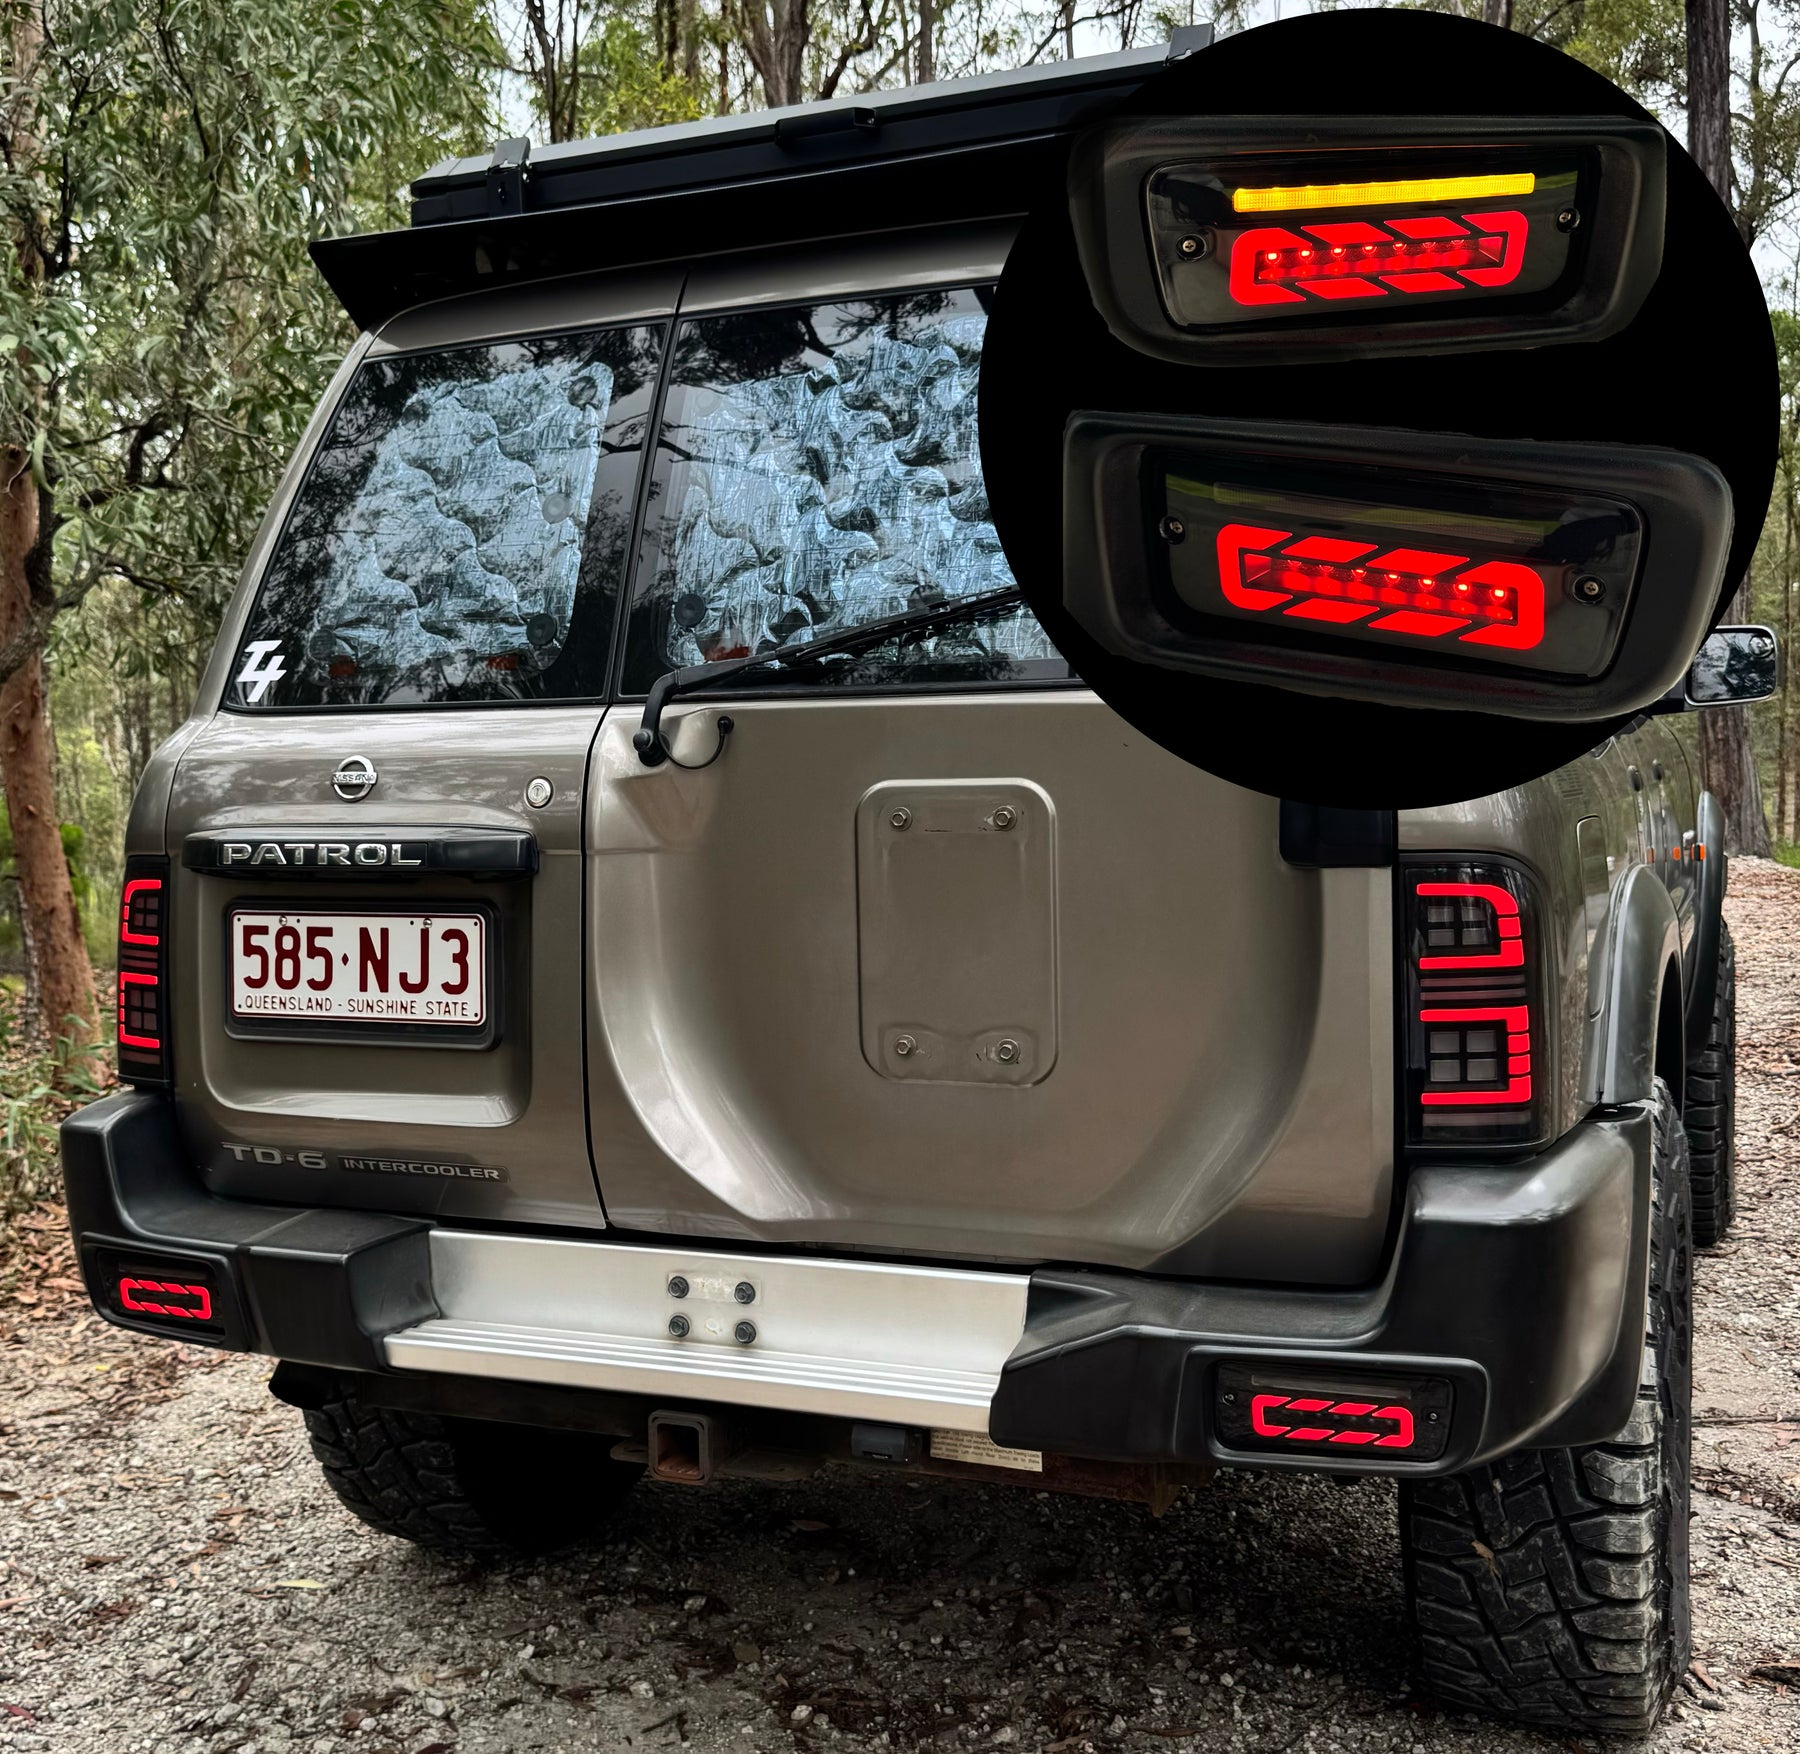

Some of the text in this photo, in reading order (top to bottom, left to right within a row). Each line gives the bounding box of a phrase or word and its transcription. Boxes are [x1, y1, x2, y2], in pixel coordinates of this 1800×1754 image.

[223, 843, 421, 865] PATROL
[245, 995, 332, 1012] QUEENSLAND
[348, 998, 417, 1015] SUNSHINE
[426, 1001, 468, 1017] STATE
[343, 1158, 500, 1180] INTERCOOLER
